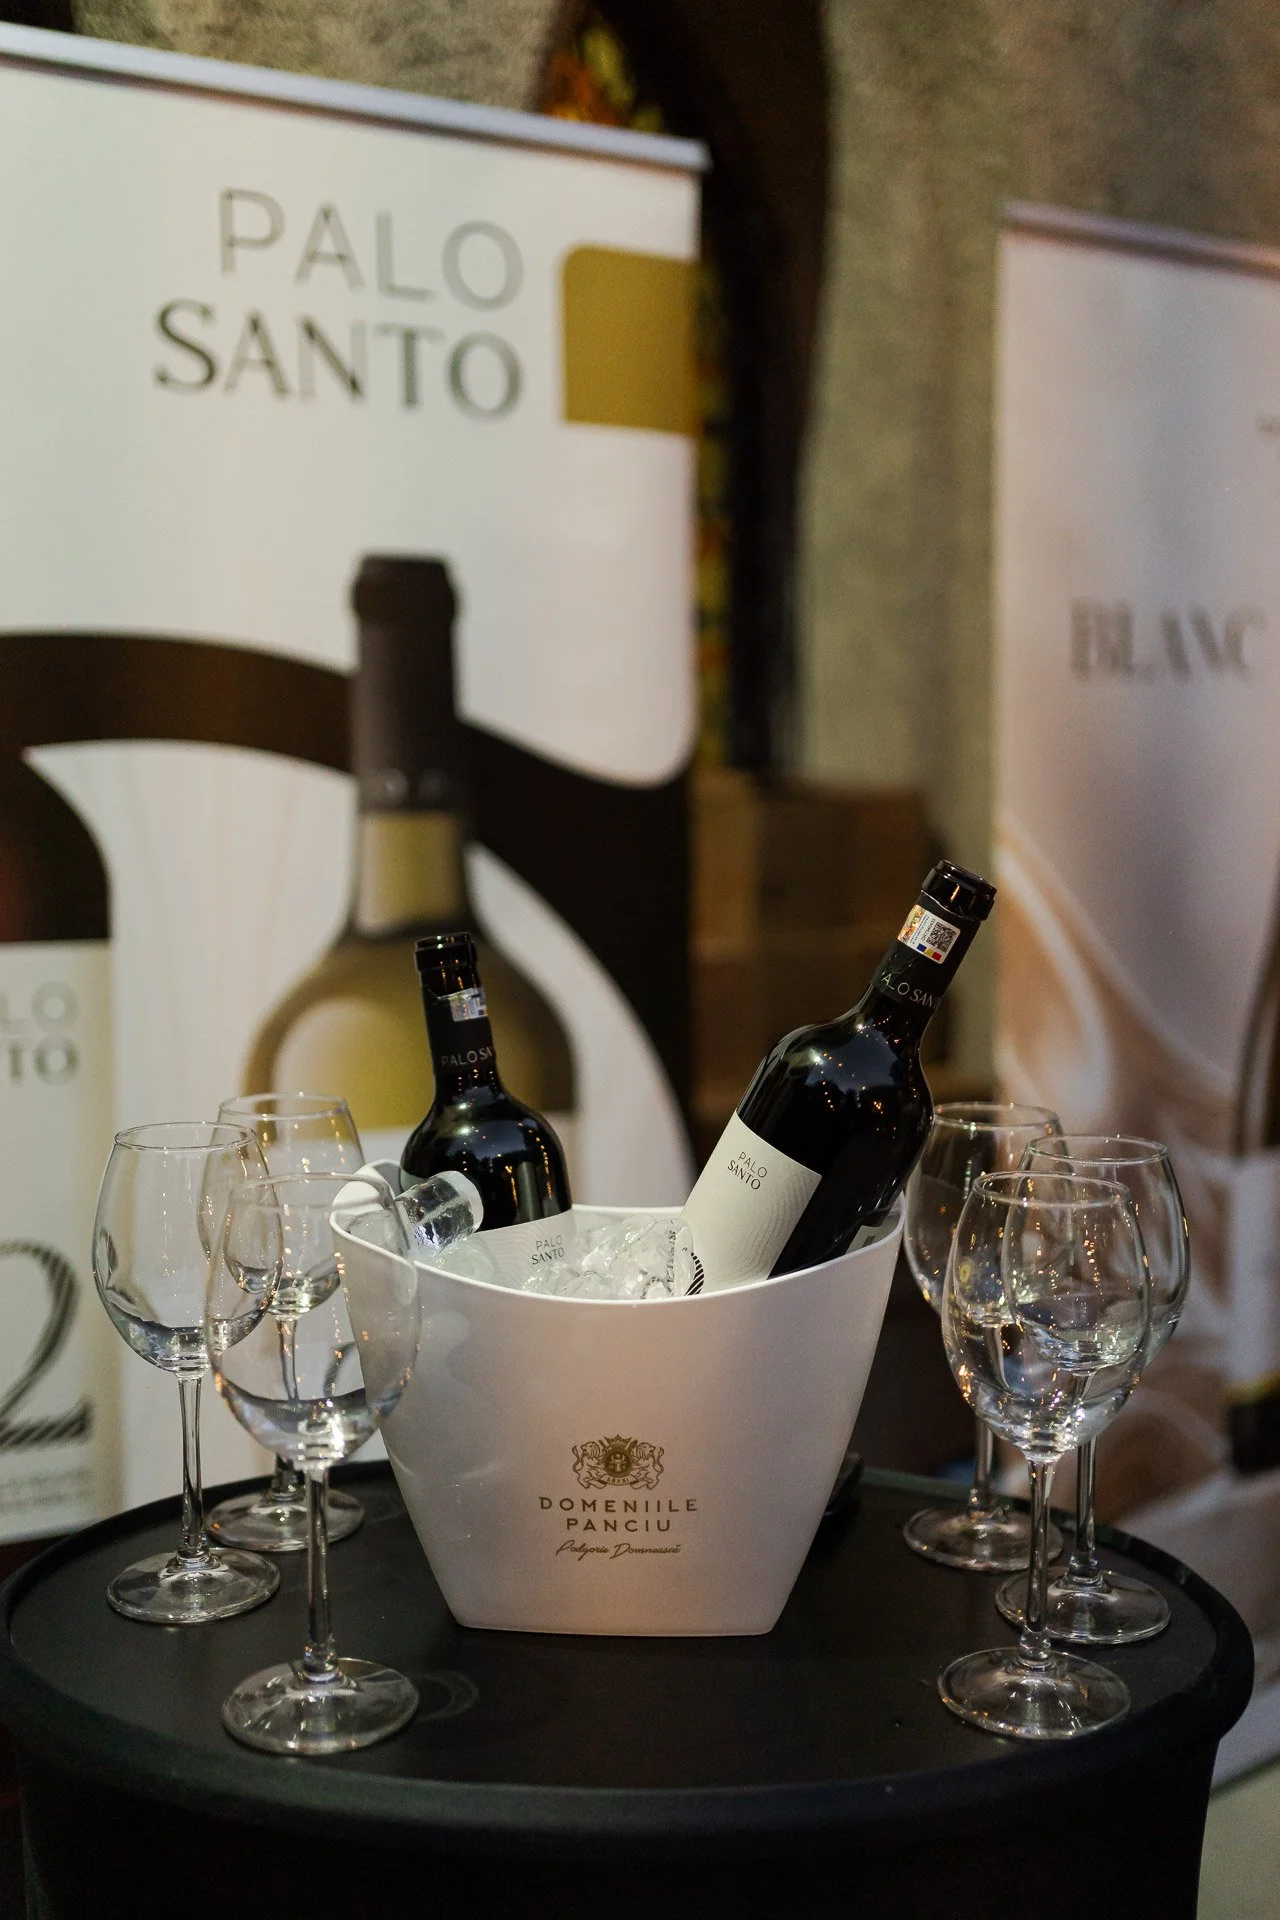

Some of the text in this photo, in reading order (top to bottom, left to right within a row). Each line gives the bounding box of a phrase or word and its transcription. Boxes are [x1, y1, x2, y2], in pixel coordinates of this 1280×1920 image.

[218, 187, 524, 311] PALO
[154, 298, 522, 422] SANTO
[727, 1159, 761, 1190] SANTO
[737, 1151, 768, 1178] PALO
[535, 1234, 562, 1251] PALO
[531, 1247, 564, 1265] SANTO
[538, 1496, 698, 1513] DOMENIILE
[566, 1518, 671, 1532] PANCIU
